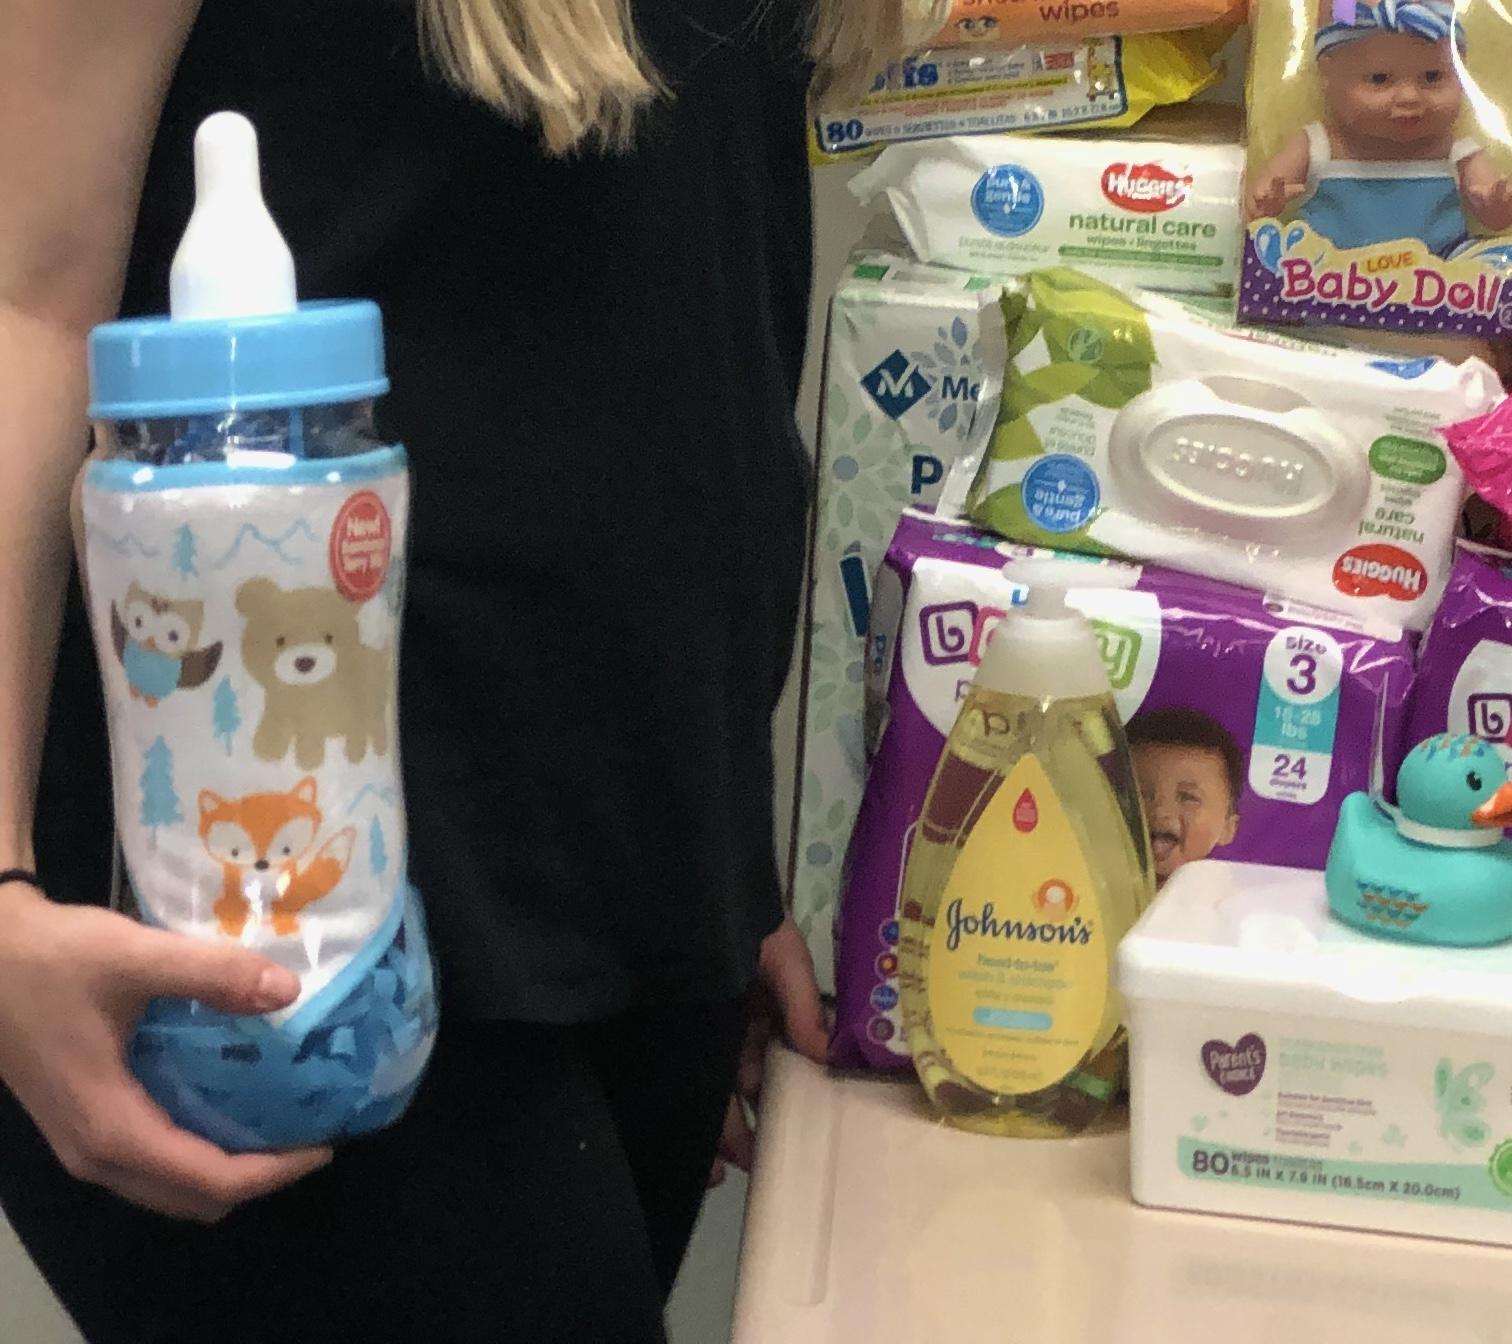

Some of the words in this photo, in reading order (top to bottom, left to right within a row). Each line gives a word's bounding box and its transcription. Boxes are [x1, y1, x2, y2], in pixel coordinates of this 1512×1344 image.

[826, 118, 864, 143] 80
[1069, 212, 1157, 234] natural
[1162, 216, 1217, 238] care
[1366, 251, 1413, 273] LOVE
[1281, 258, 1399, 309] Baby
[1411, 269, 1501, 313] Doll
[942, 375, 981, 403] Me
[1375, 507, 1416, 525] care
[1358, 520, 1425, 544] natural
[1286, 653, 1318, 696] 3
[1272, 753, 1308, 780] 24
[946, 896, 1094, 952] Johnson's
[1192, 1149, 1230, 1176] 80
[1230, 1150, 1270, 1165] wipes
